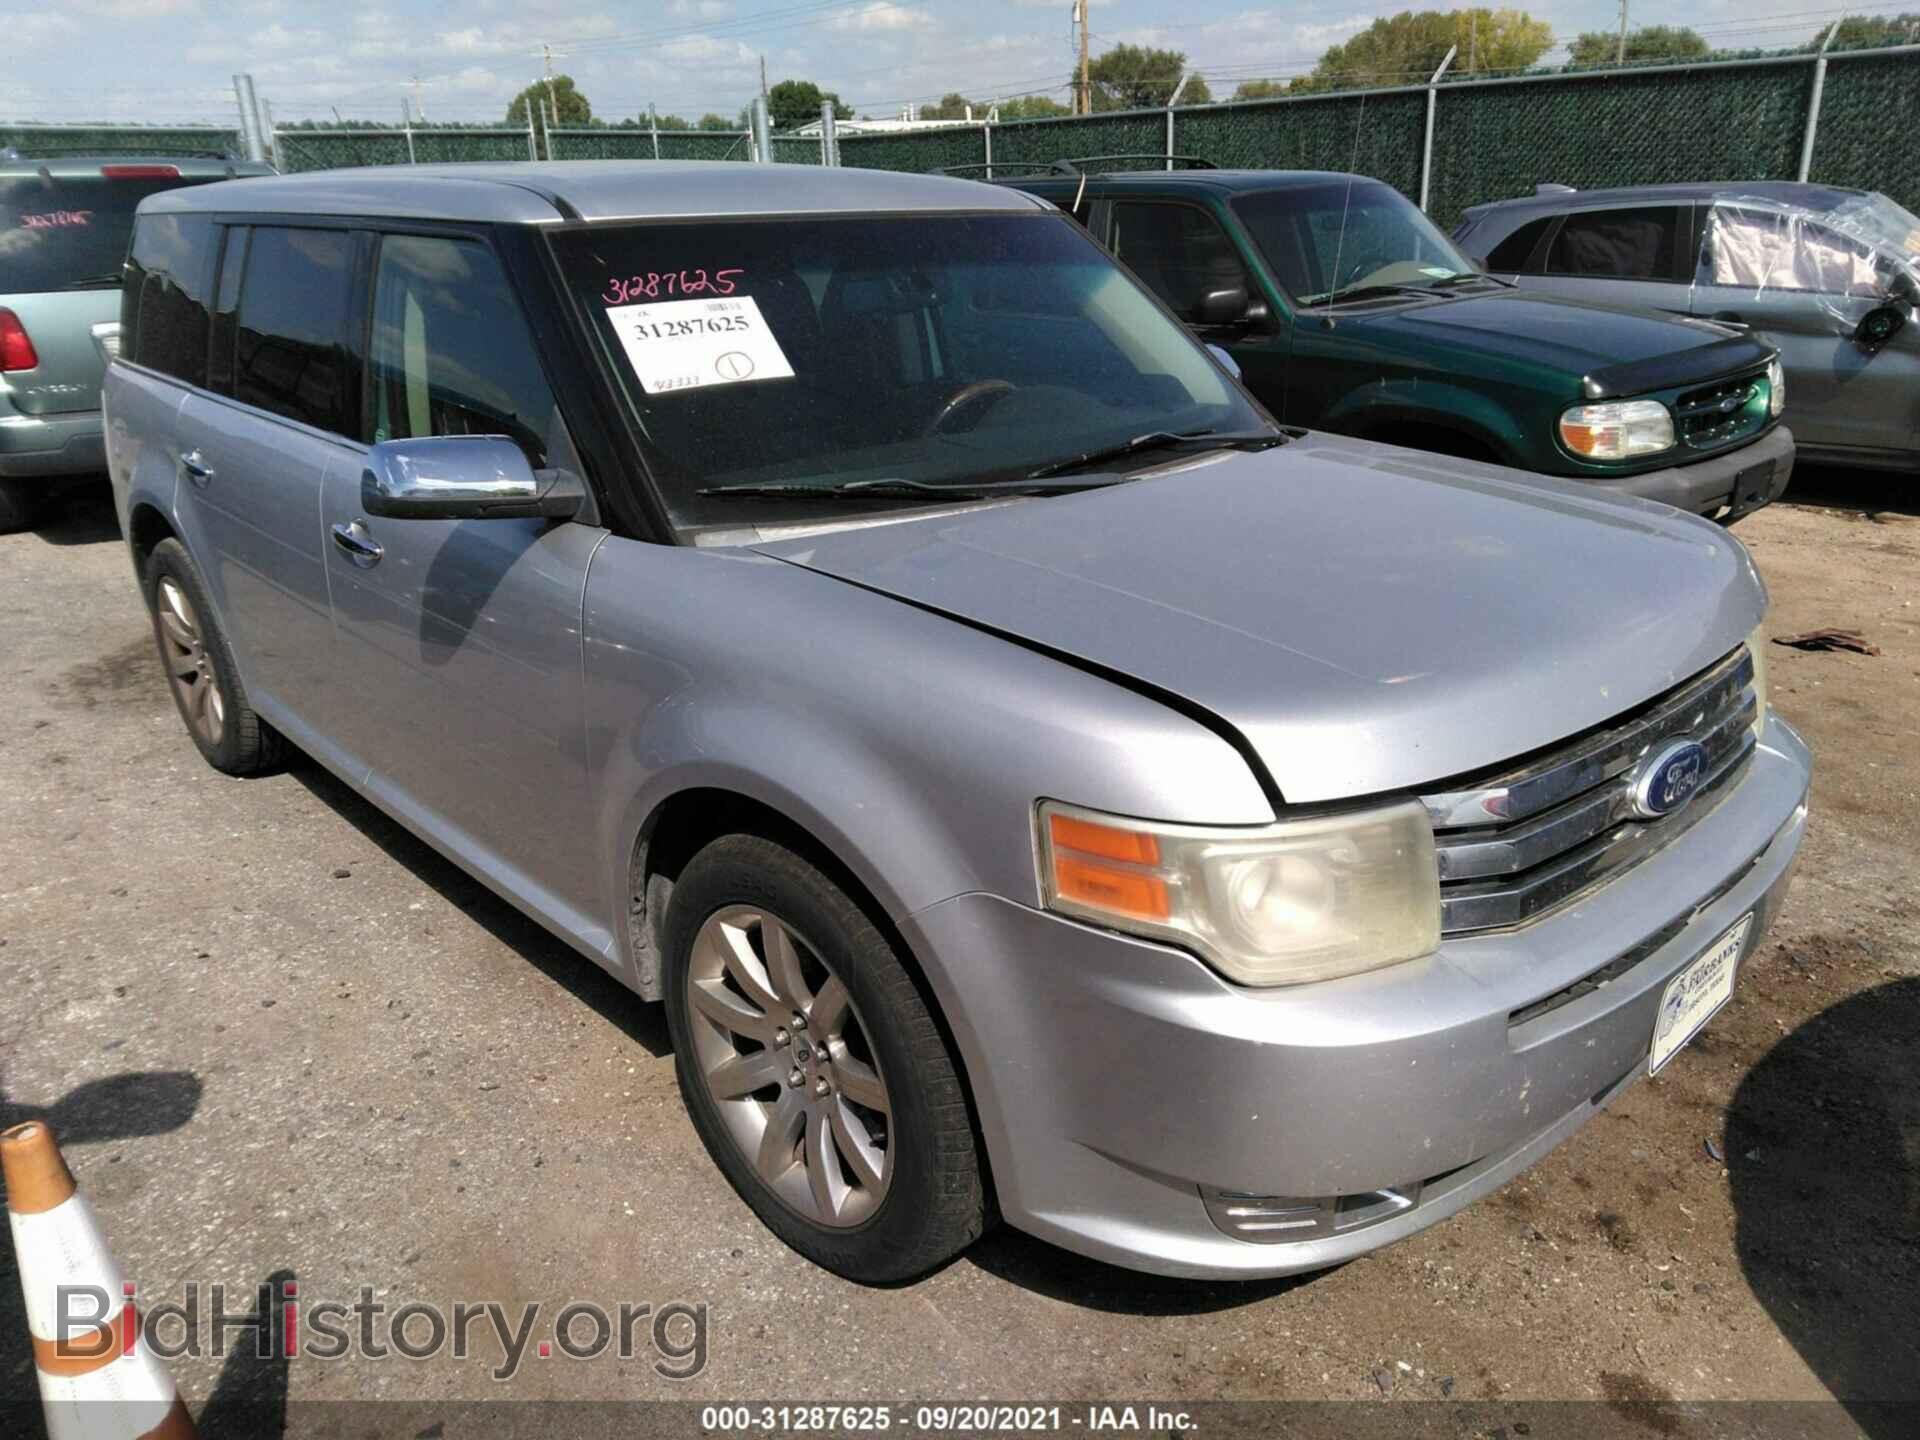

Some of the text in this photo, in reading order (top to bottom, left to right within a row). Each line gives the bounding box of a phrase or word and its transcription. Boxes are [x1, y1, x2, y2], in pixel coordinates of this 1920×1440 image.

[602, 269, 744, 304] 31287625
[633, 315, 750, 341] 31287625
[1664, 755, 1700, 803] Ford
